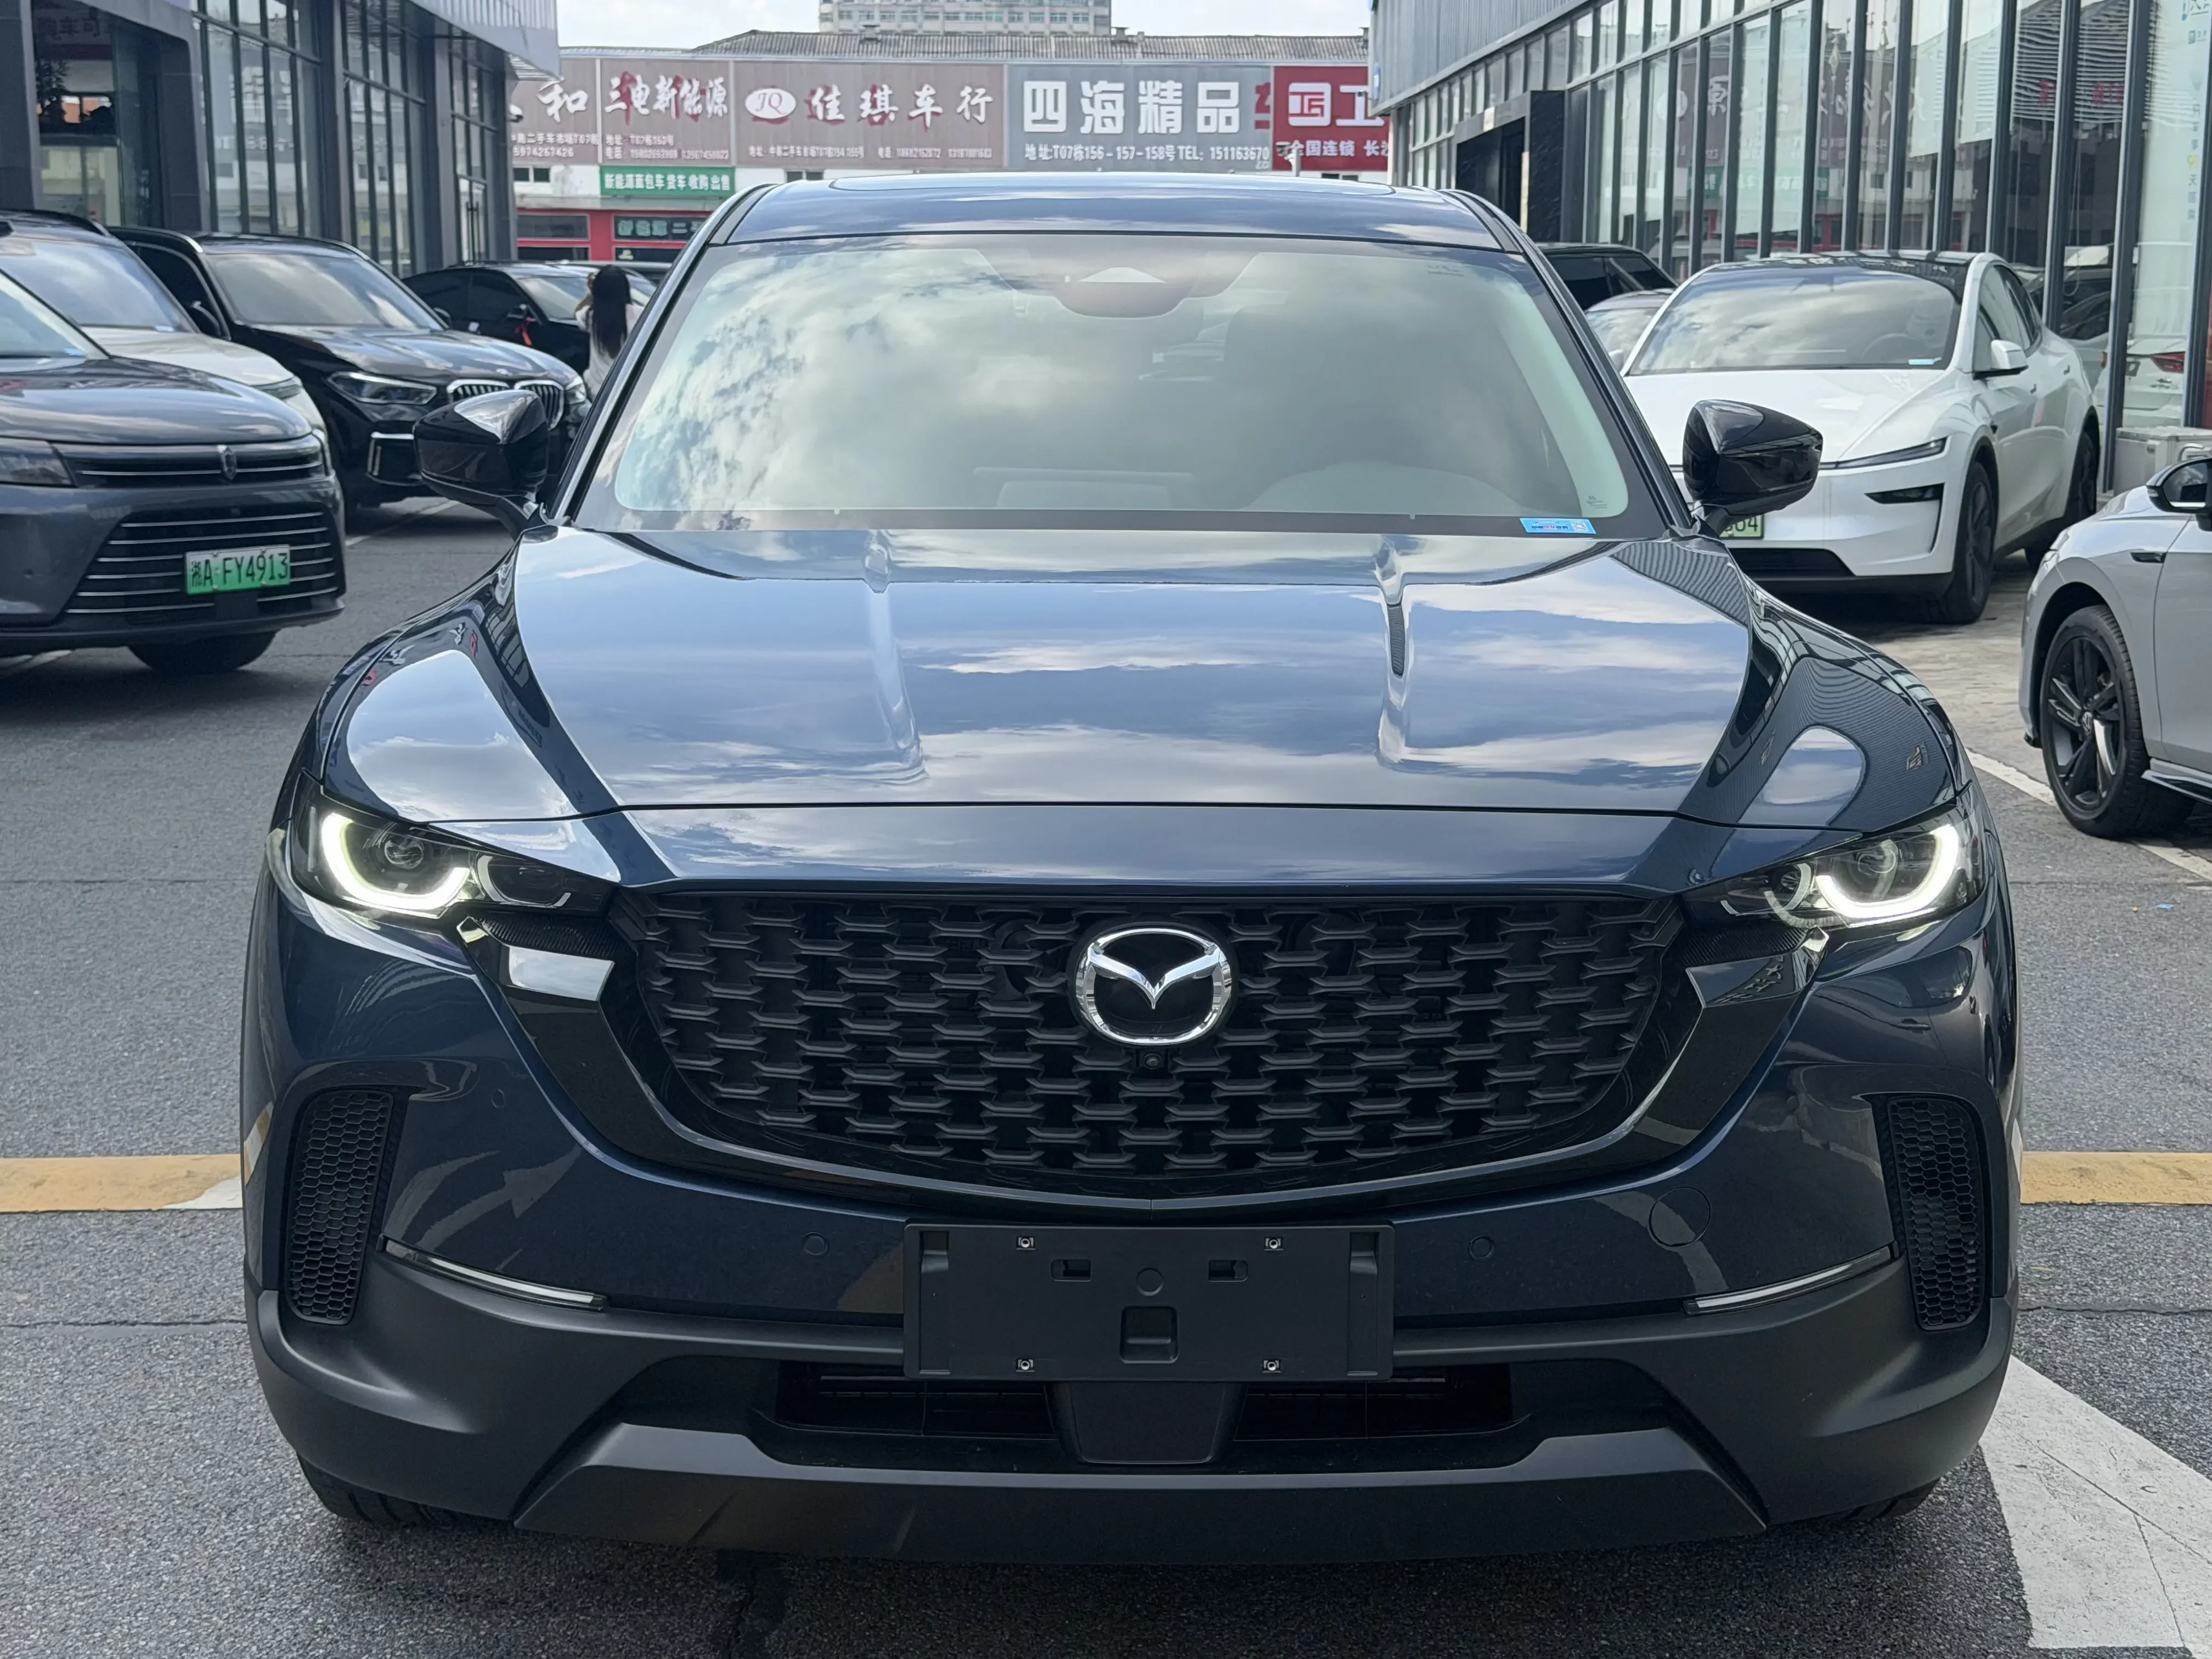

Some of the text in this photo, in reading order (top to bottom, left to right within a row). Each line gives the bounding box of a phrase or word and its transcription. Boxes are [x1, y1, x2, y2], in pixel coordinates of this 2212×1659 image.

[811, 84, 993, 127] 佳琪车行
[1023, 80, 1240, 134] 四海精品
